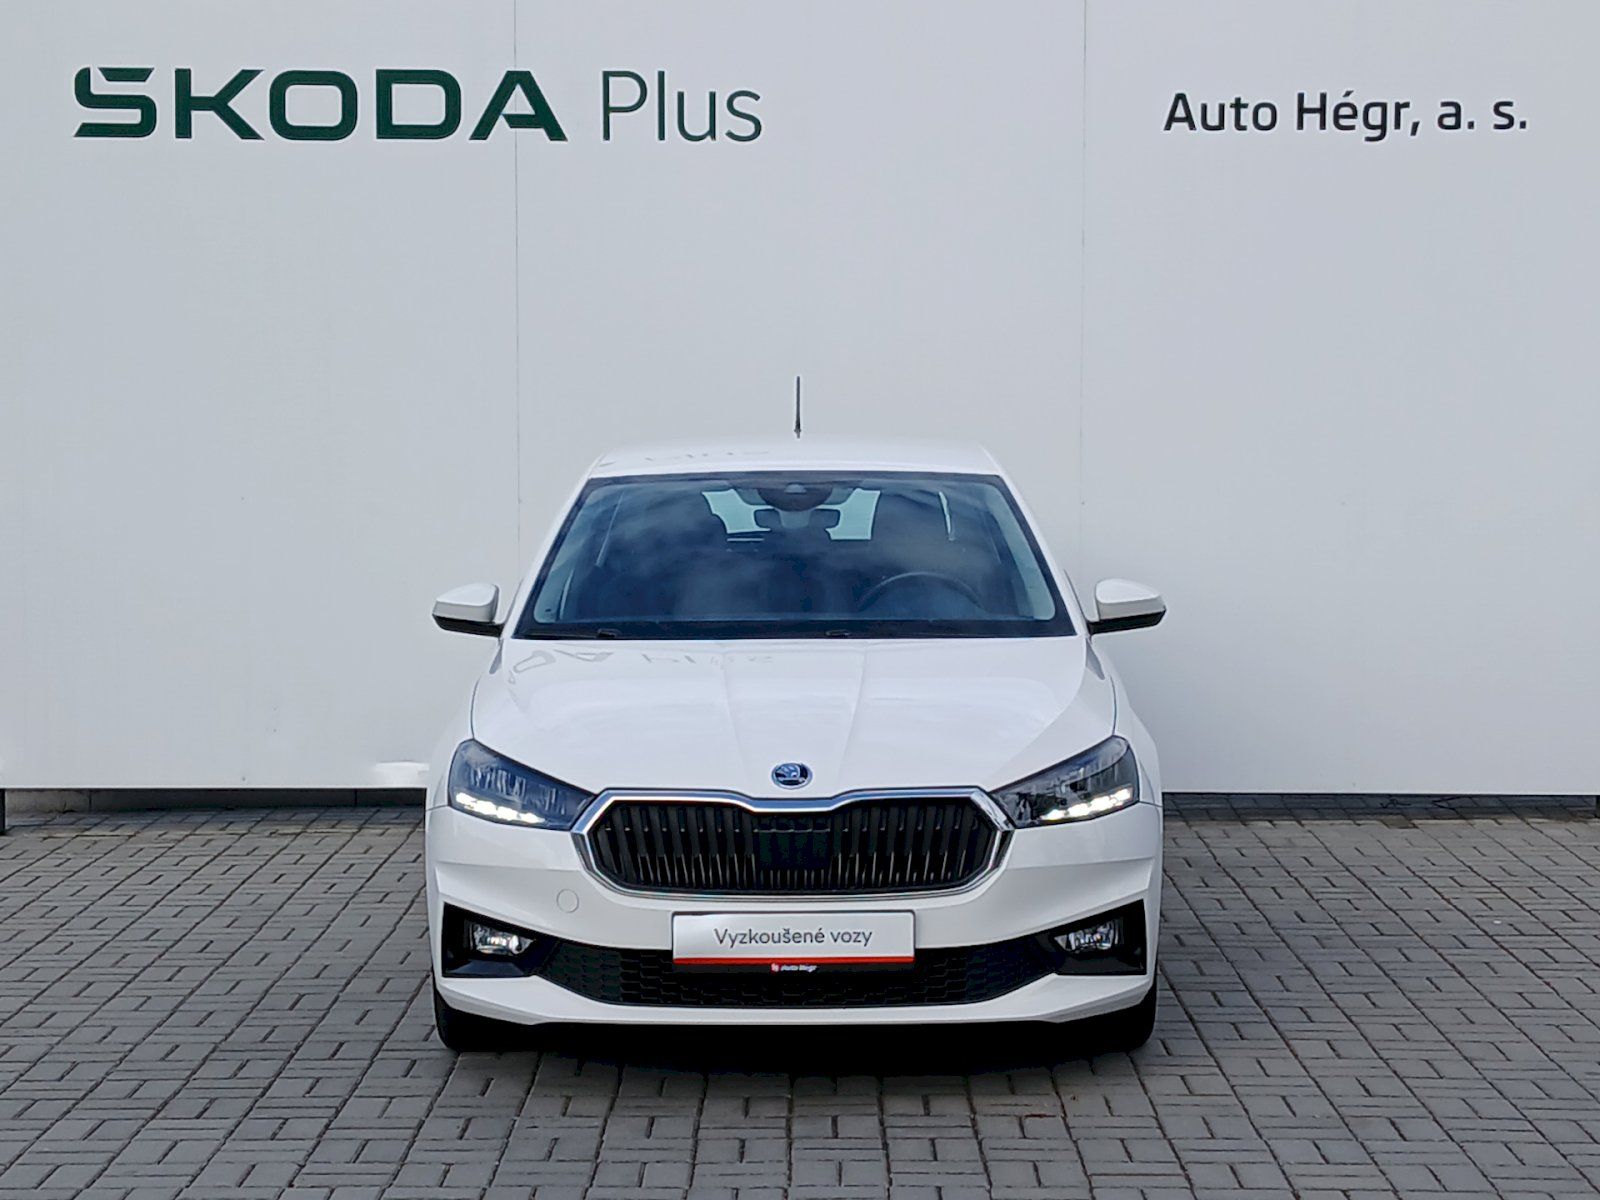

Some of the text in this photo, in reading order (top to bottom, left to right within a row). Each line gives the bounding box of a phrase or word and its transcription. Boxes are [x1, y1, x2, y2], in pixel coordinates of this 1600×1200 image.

[602, 70, 762, 142] Plus
[1164, 90, 1527, 142] Auto Hégr, a. s.
[714, 928, 872, 948] Vyzkoušené vozy
